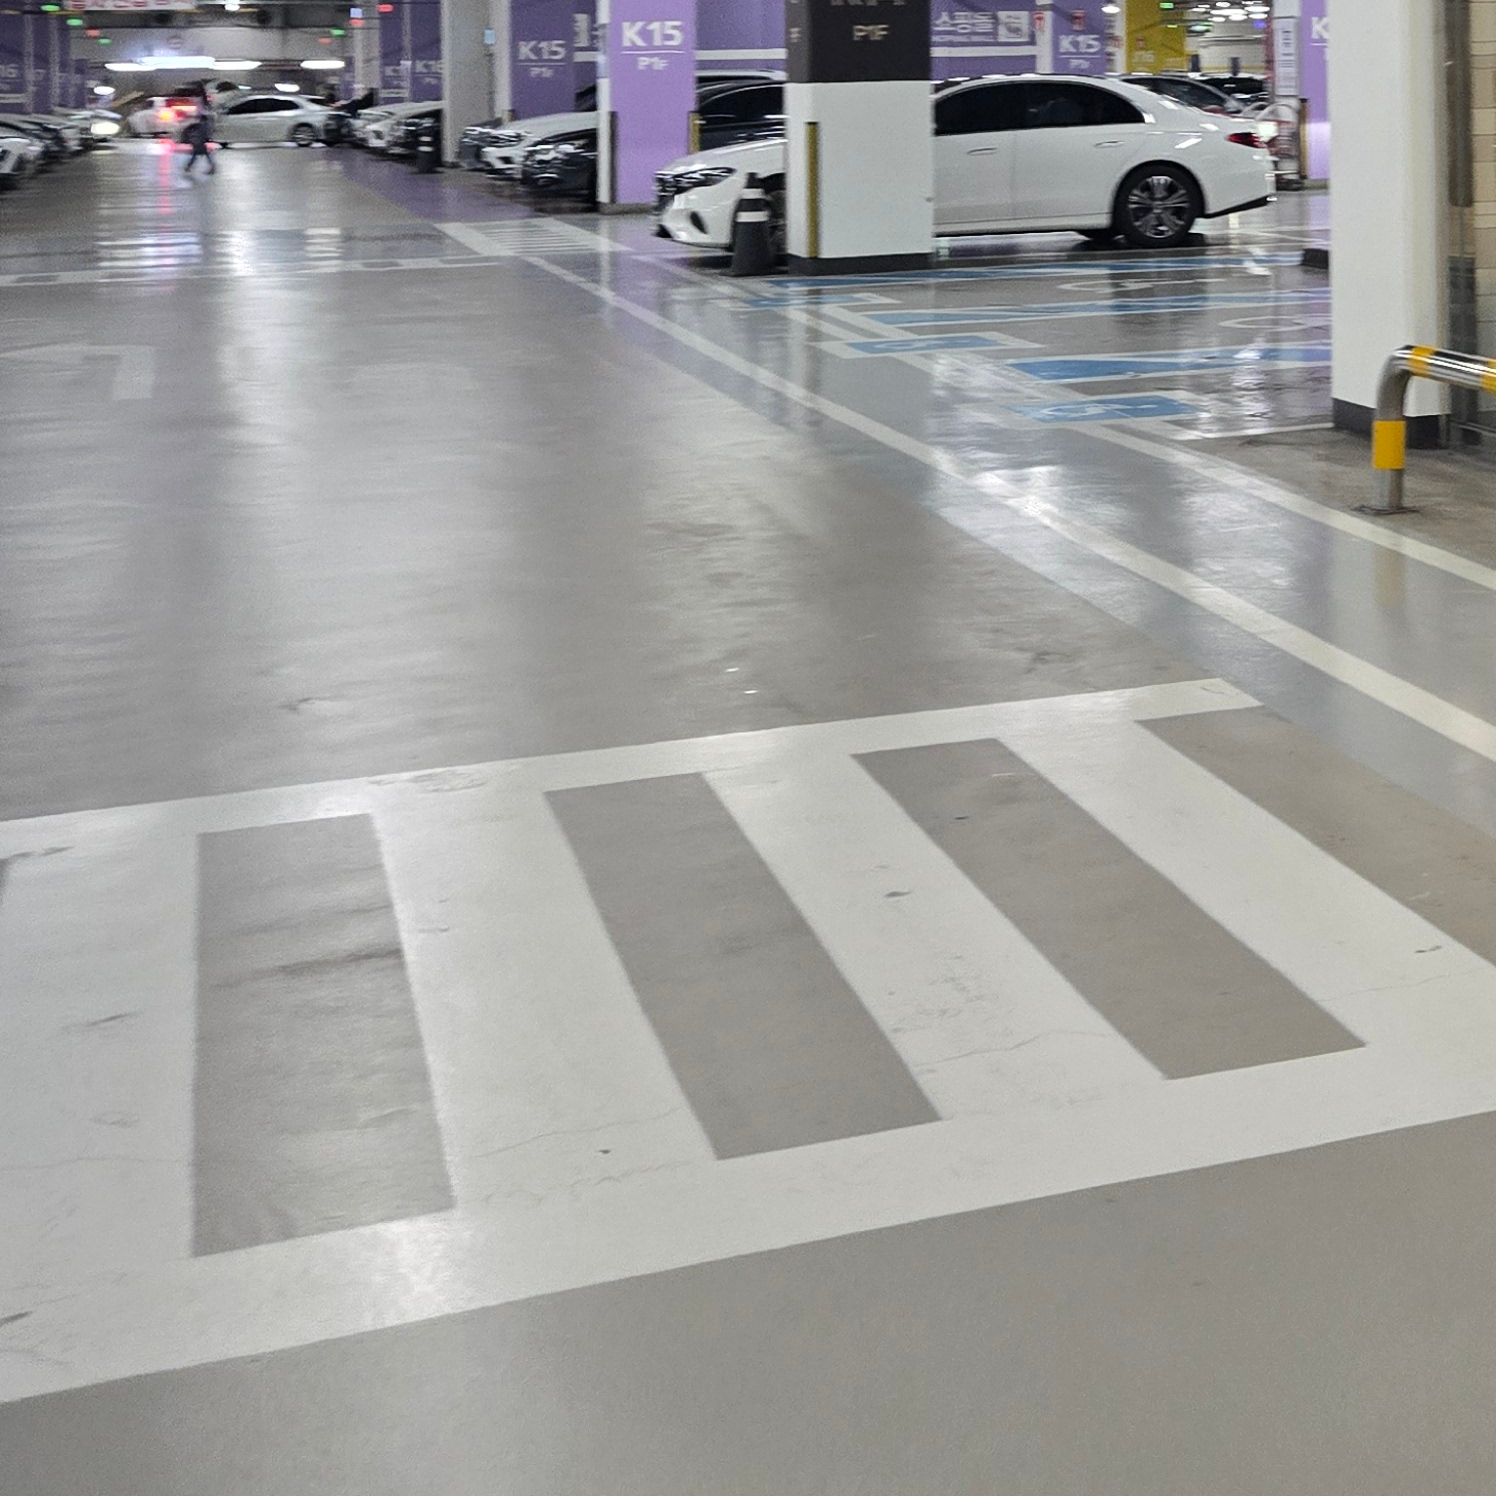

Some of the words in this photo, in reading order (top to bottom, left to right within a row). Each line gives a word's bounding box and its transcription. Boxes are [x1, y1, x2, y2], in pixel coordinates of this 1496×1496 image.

[932, 11, 995, 33] 쇼핑몰
[621, 20, 684, 47] K15
[1059, 34, 1102, 53] K15
[518, 40, 567, 60] K15
